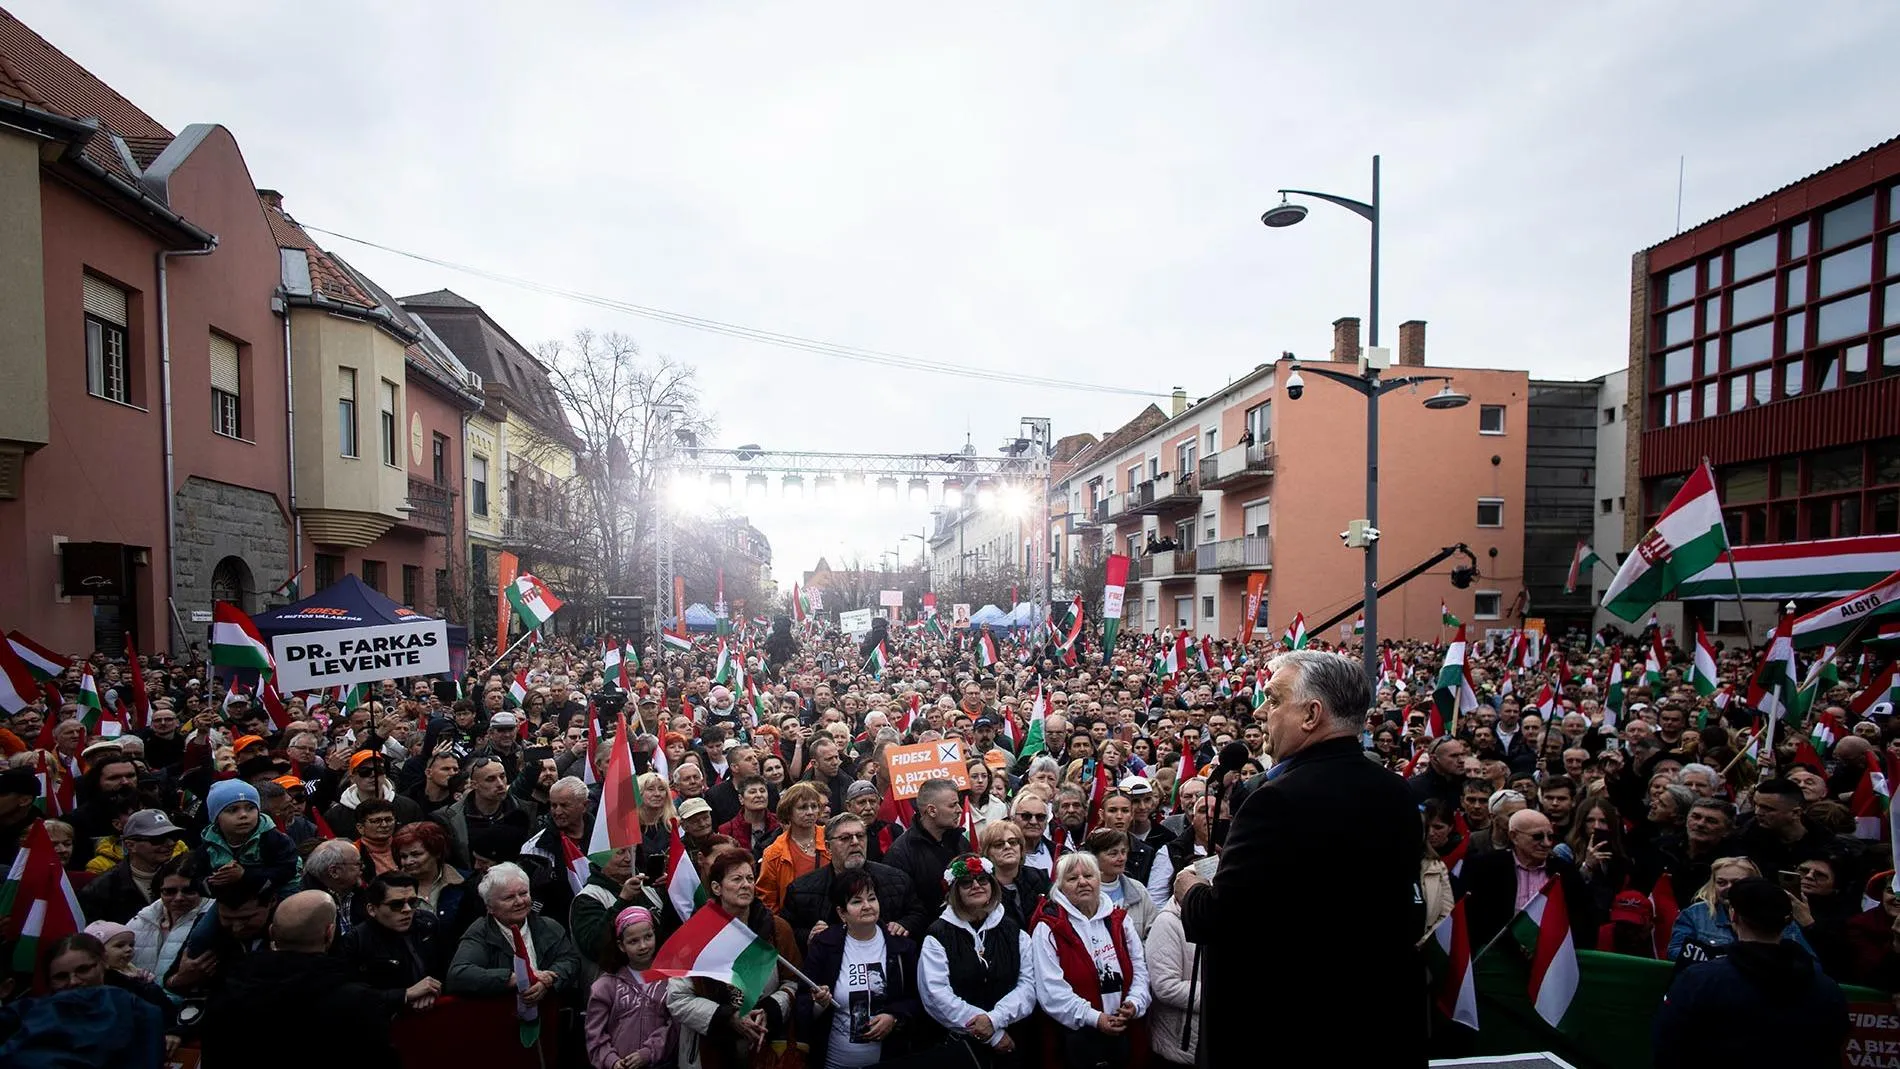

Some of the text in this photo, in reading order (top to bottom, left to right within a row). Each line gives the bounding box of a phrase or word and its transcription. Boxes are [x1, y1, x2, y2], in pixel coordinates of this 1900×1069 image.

[300, 607, 349, 615] FIDESZ
[1840, 594, 1881, 617] ALGYŐ
[286, 632, 438, 662] DR. FARKAS
[309, 651, 421, 677] LEVENTE
[891, 750, 932, 766] FIDESZ
[895, 768, 949, 785] A BIZTOS
[849, 963, 866, 975] 20
[849, 974, 867, 986] 26
[1847, 1012, 1900, 1030] FIDES
[1846, 1038, 1900, 1054] A BIZ
[1846, 1051, 1900, 1069] VÁLA
